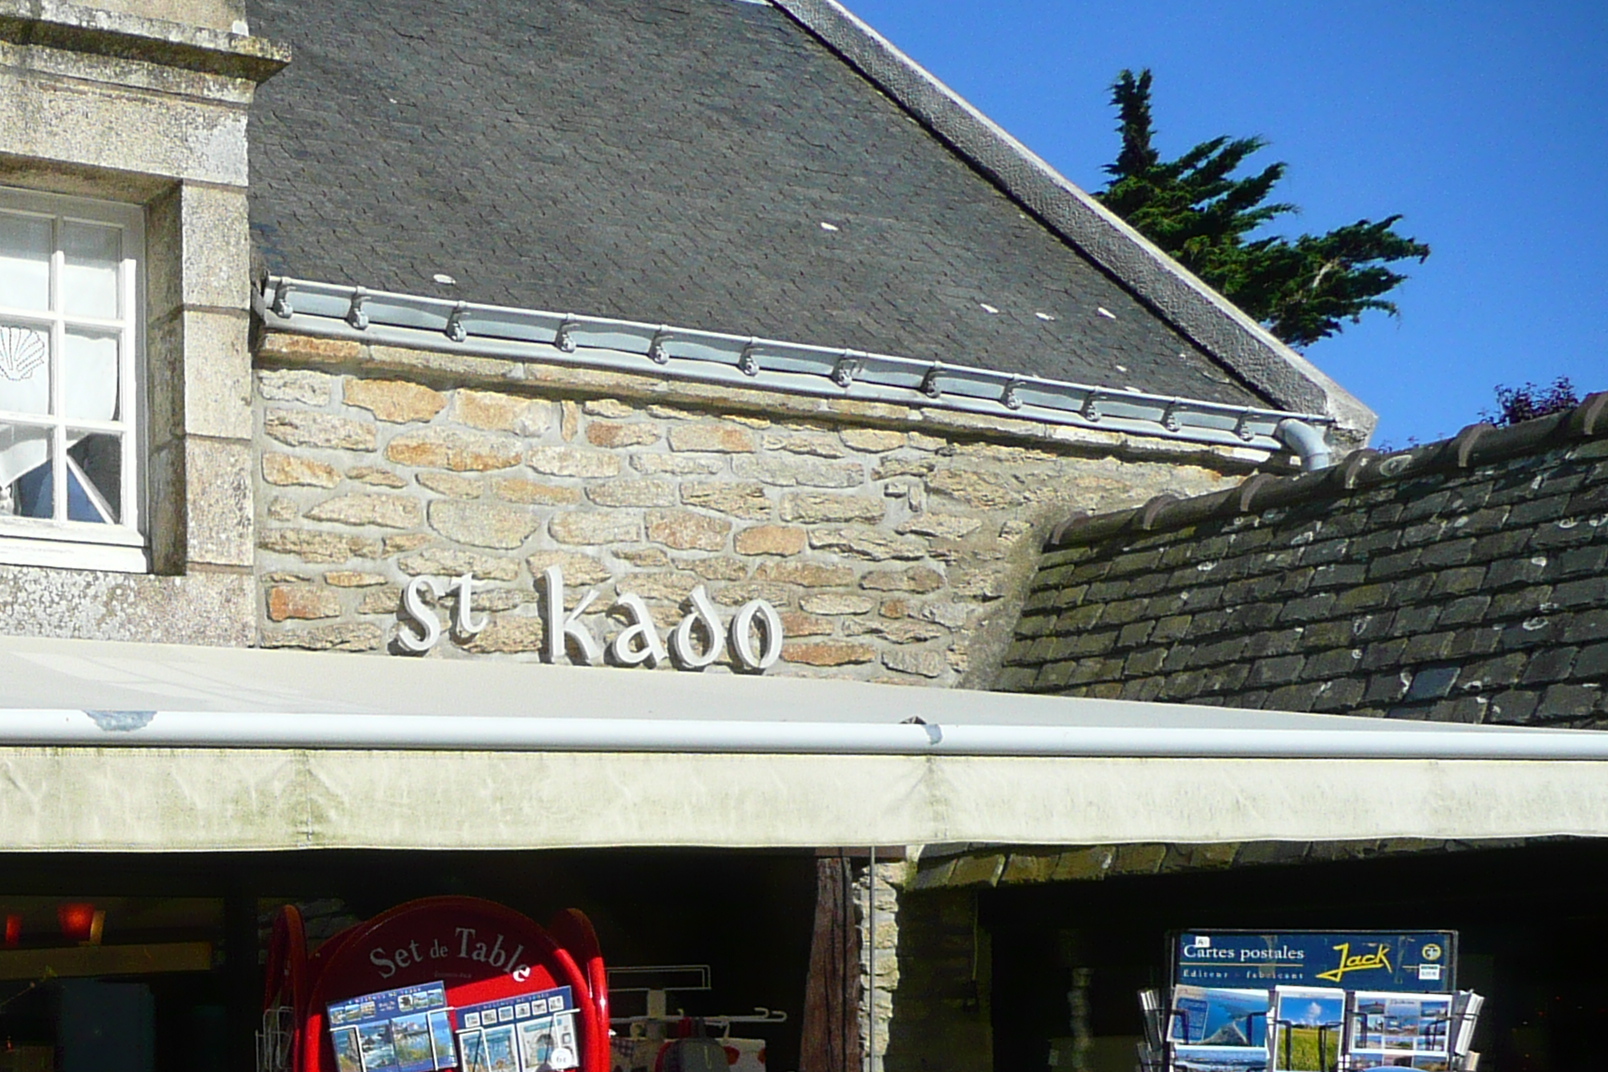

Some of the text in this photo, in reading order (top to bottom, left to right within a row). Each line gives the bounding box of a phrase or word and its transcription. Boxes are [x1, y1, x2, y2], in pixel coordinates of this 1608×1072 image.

[369, 927, 531, 983] Set de Table
[1183, 943, 1305, 962] Cartes postales
[1315, 942, 1393, 983] Jack
